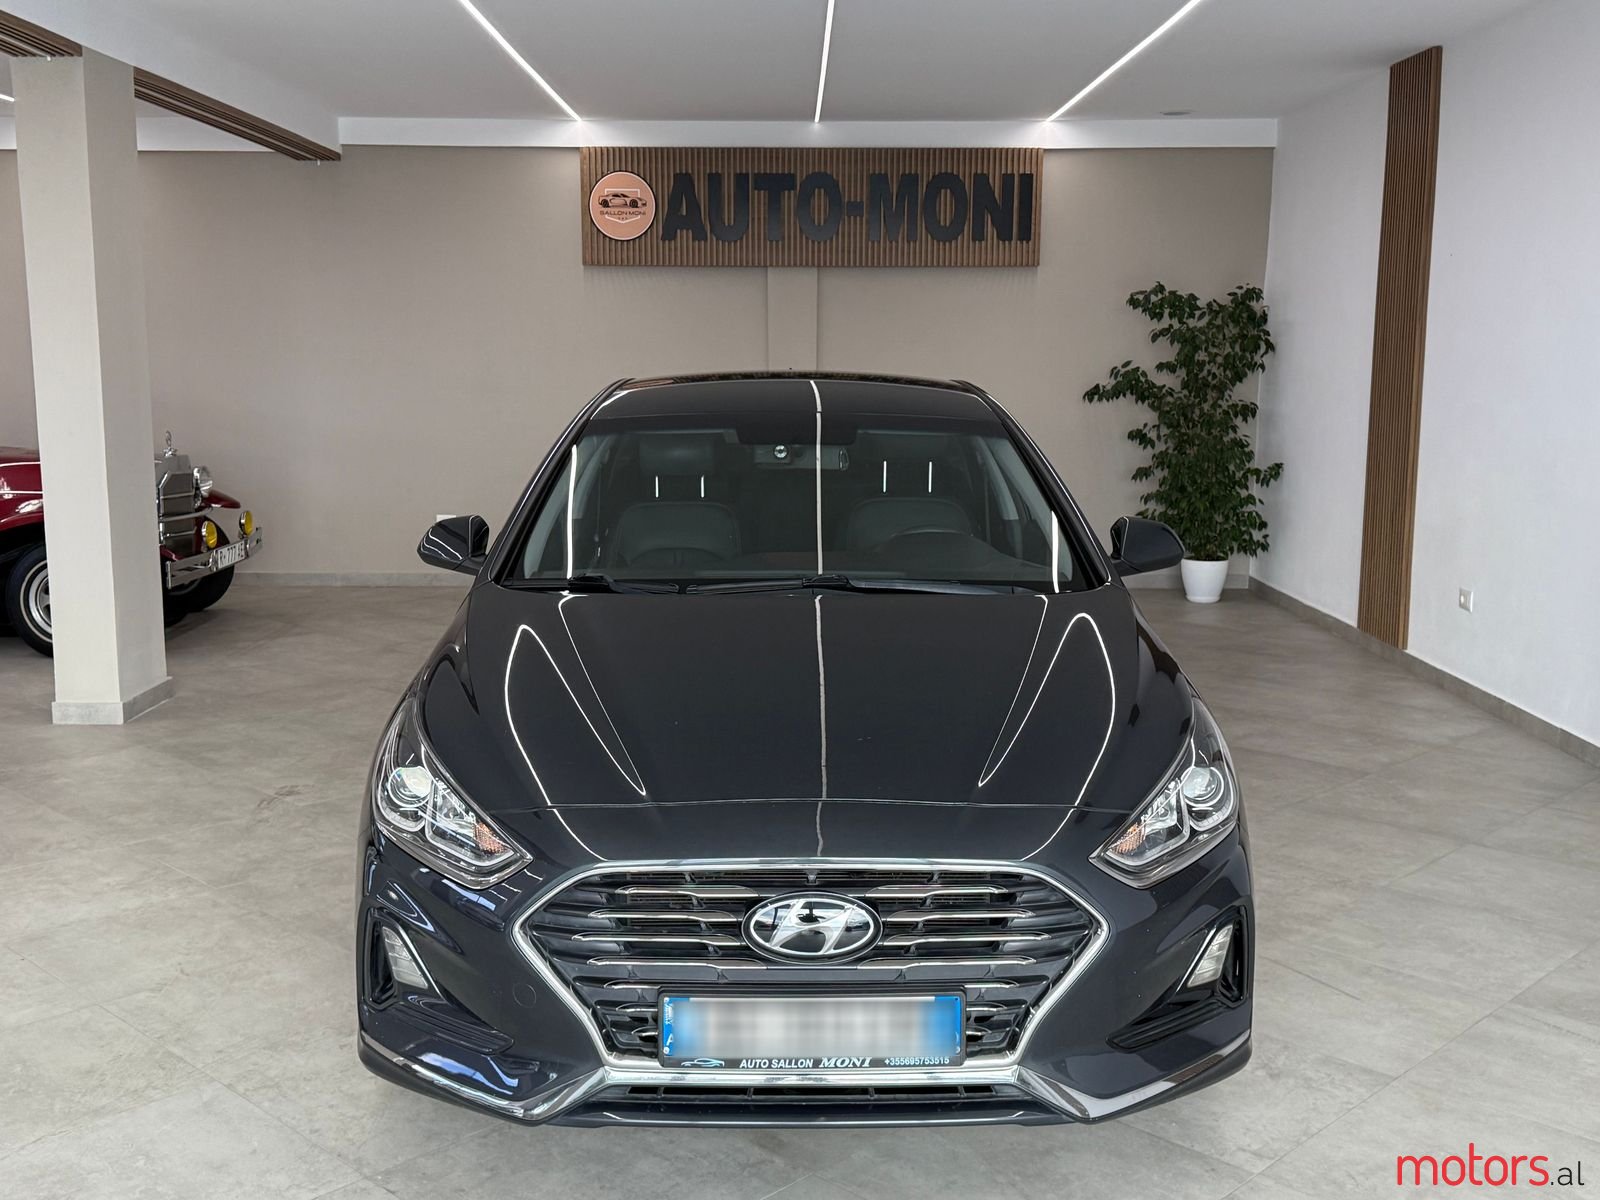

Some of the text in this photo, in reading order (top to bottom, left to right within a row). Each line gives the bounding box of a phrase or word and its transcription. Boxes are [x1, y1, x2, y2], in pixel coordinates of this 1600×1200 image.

[661, 171, 1034, 242] AUTO-MONI
[739, 1056, 950, 1069] AUTO SALLON MONI +355695753515
